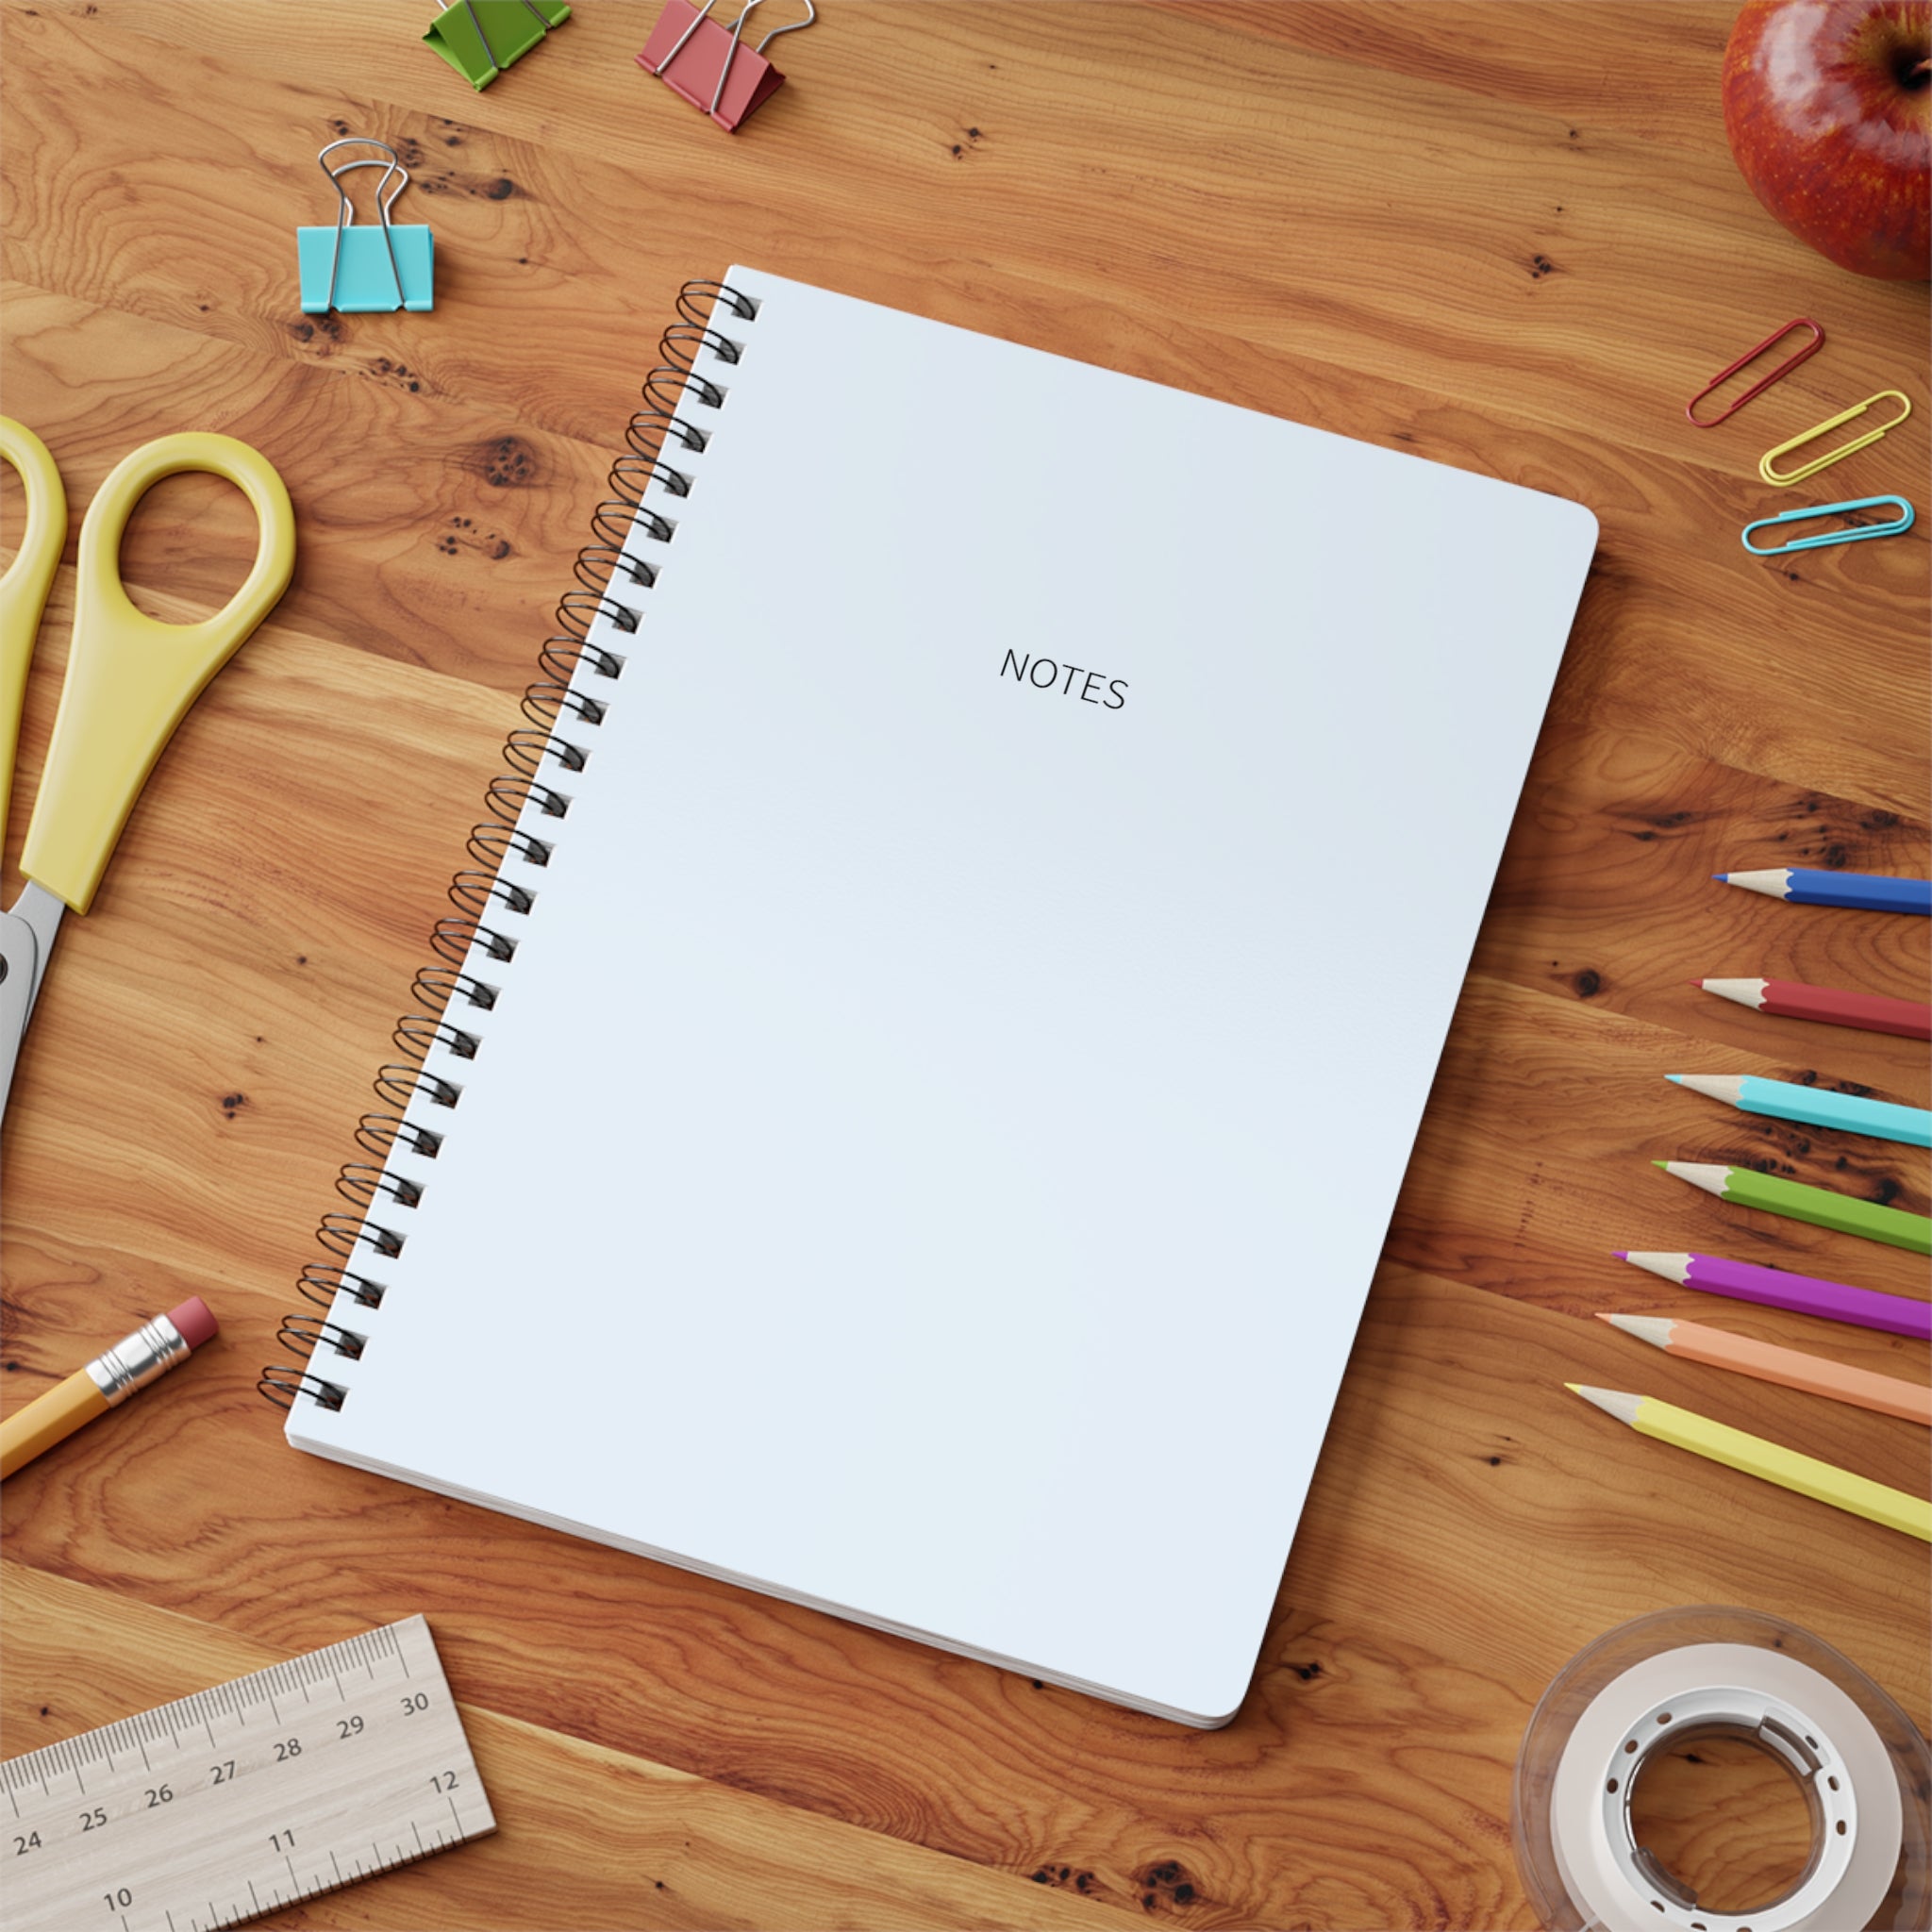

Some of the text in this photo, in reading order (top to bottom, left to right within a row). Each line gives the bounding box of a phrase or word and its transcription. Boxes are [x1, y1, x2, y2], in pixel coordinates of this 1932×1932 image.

[1000, 648, 1130, 710] NOTES
[14, 1692, 430, 1856] 24 25 26 27 28 29 30
[105, 1771, 460, 1912] 10 11 12
